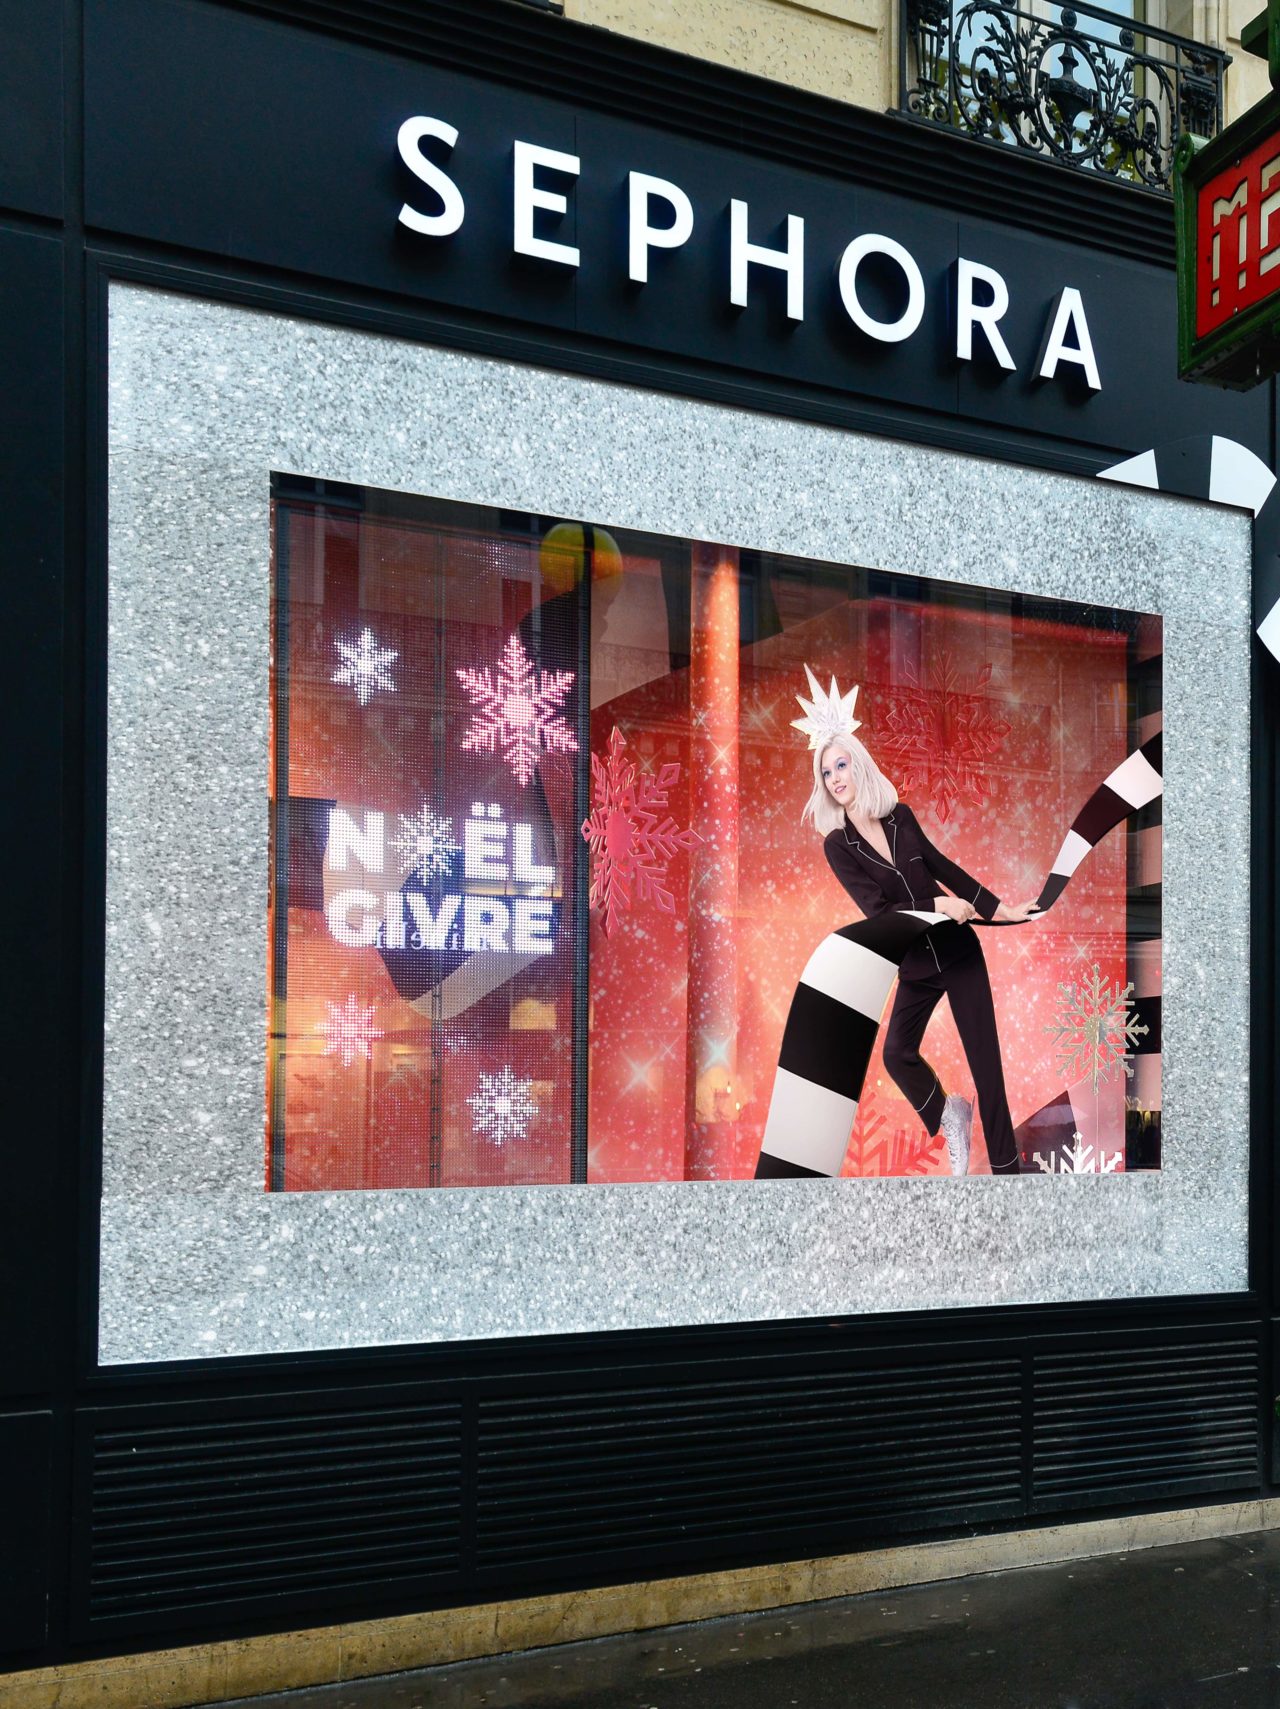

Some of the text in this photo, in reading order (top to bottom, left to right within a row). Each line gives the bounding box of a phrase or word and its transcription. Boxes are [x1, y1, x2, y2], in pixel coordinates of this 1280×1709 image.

[397, 116, 1101, 391] SEPHORA
[326, 799, 556, 885] NËL
[325, 883, 556, 954] GIVRÉ
